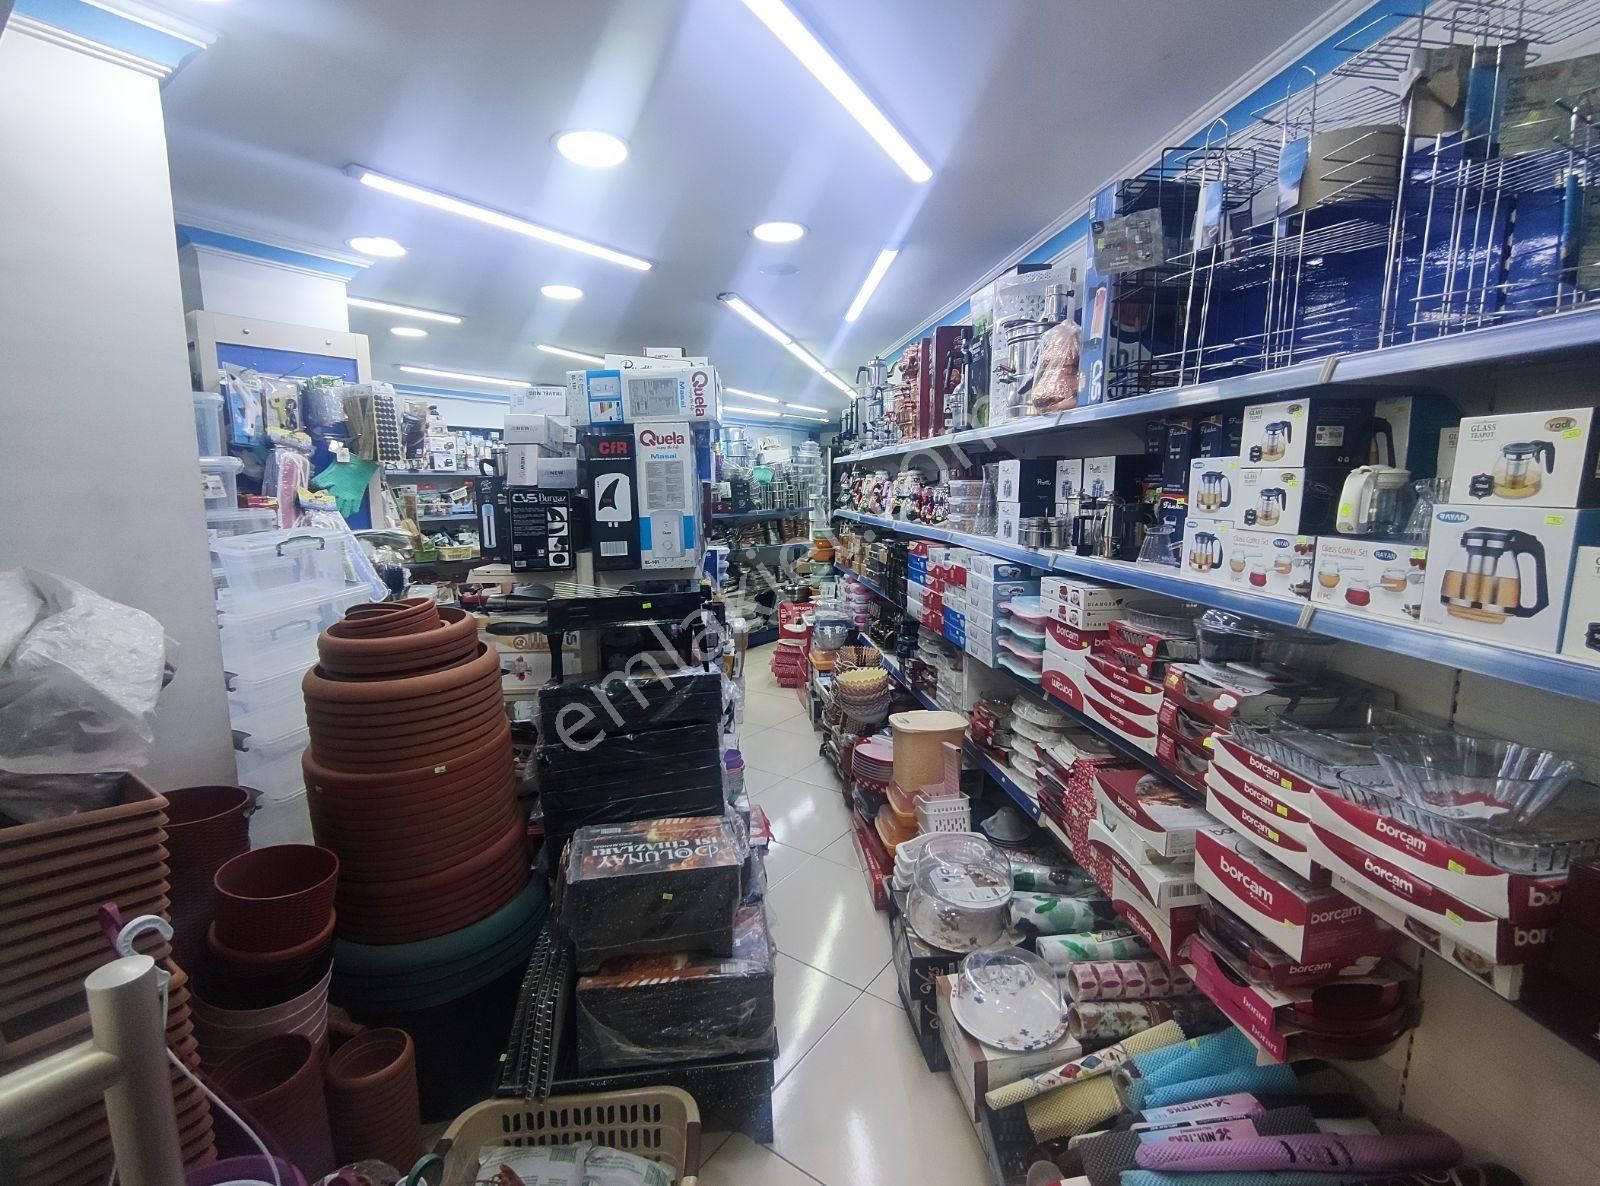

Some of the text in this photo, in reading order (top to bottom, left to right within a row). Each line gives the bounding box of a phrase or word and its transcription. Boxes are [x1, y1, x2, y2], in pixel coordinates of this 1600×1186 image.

[691, 370, 709, 417] Quela
[639, 429, 685, 447] Quela
[1471, 424, 1497, 432] GLASS
[1375, 550, 1397, 561] RAYAN
[1056, 625, 1079, 642] borcam
[1052, 677, 1073, 699] borcam
[1249, 755, 1280, 779] borcam
[1117, 796, 1137, 816] borcam
[1243, 782, 1274, 807] borcam
[1241, 809, 1271, 835] borcam
[1376, 818, 1427, 852] borcam
[596, 844, 720, 869] DOLUNAY
[1112, 854, 1131, 878] borcam
[1220, 856, 1273, 905] borcam
[1364, 858, 1414, 894] borcam
[1310, 904, 1362, 925] borcam
[1126, 911, 1152, 943] borcam
[1289, 961, 1332, 975] borcam
